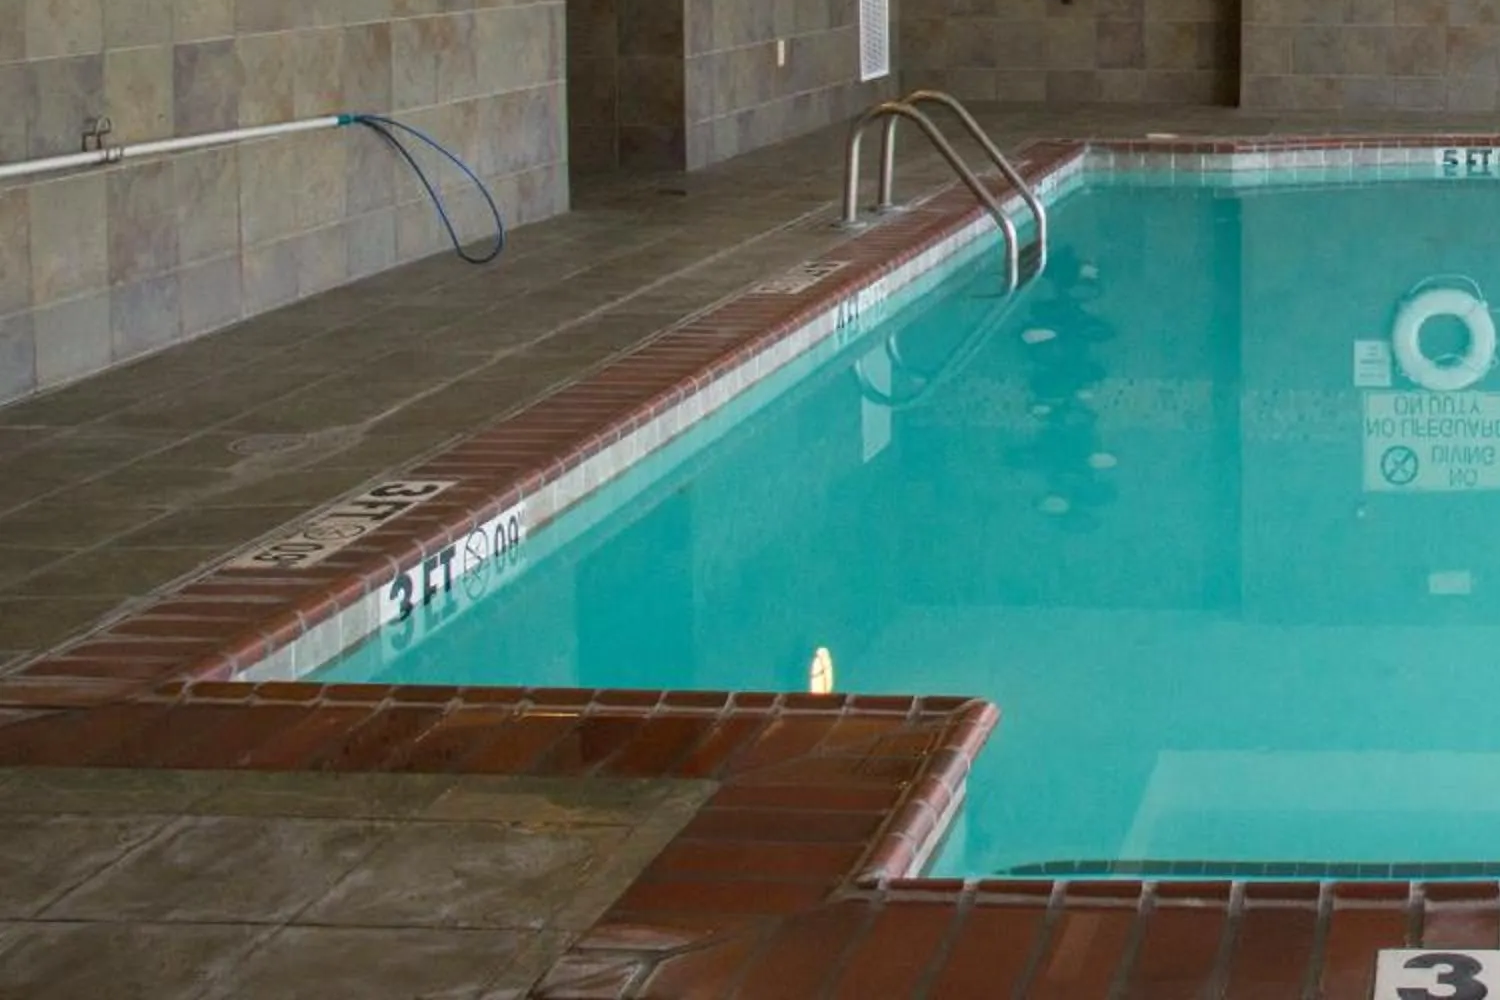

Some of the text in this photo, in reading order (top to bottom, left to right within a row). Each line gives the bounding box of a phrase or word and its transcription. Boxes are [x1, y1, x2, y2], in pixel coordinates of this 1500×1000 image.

[389, 573, 413, 623] 3
[423, 545, 456, 606] FT
[1396, 953, 1488, 1000] 3
